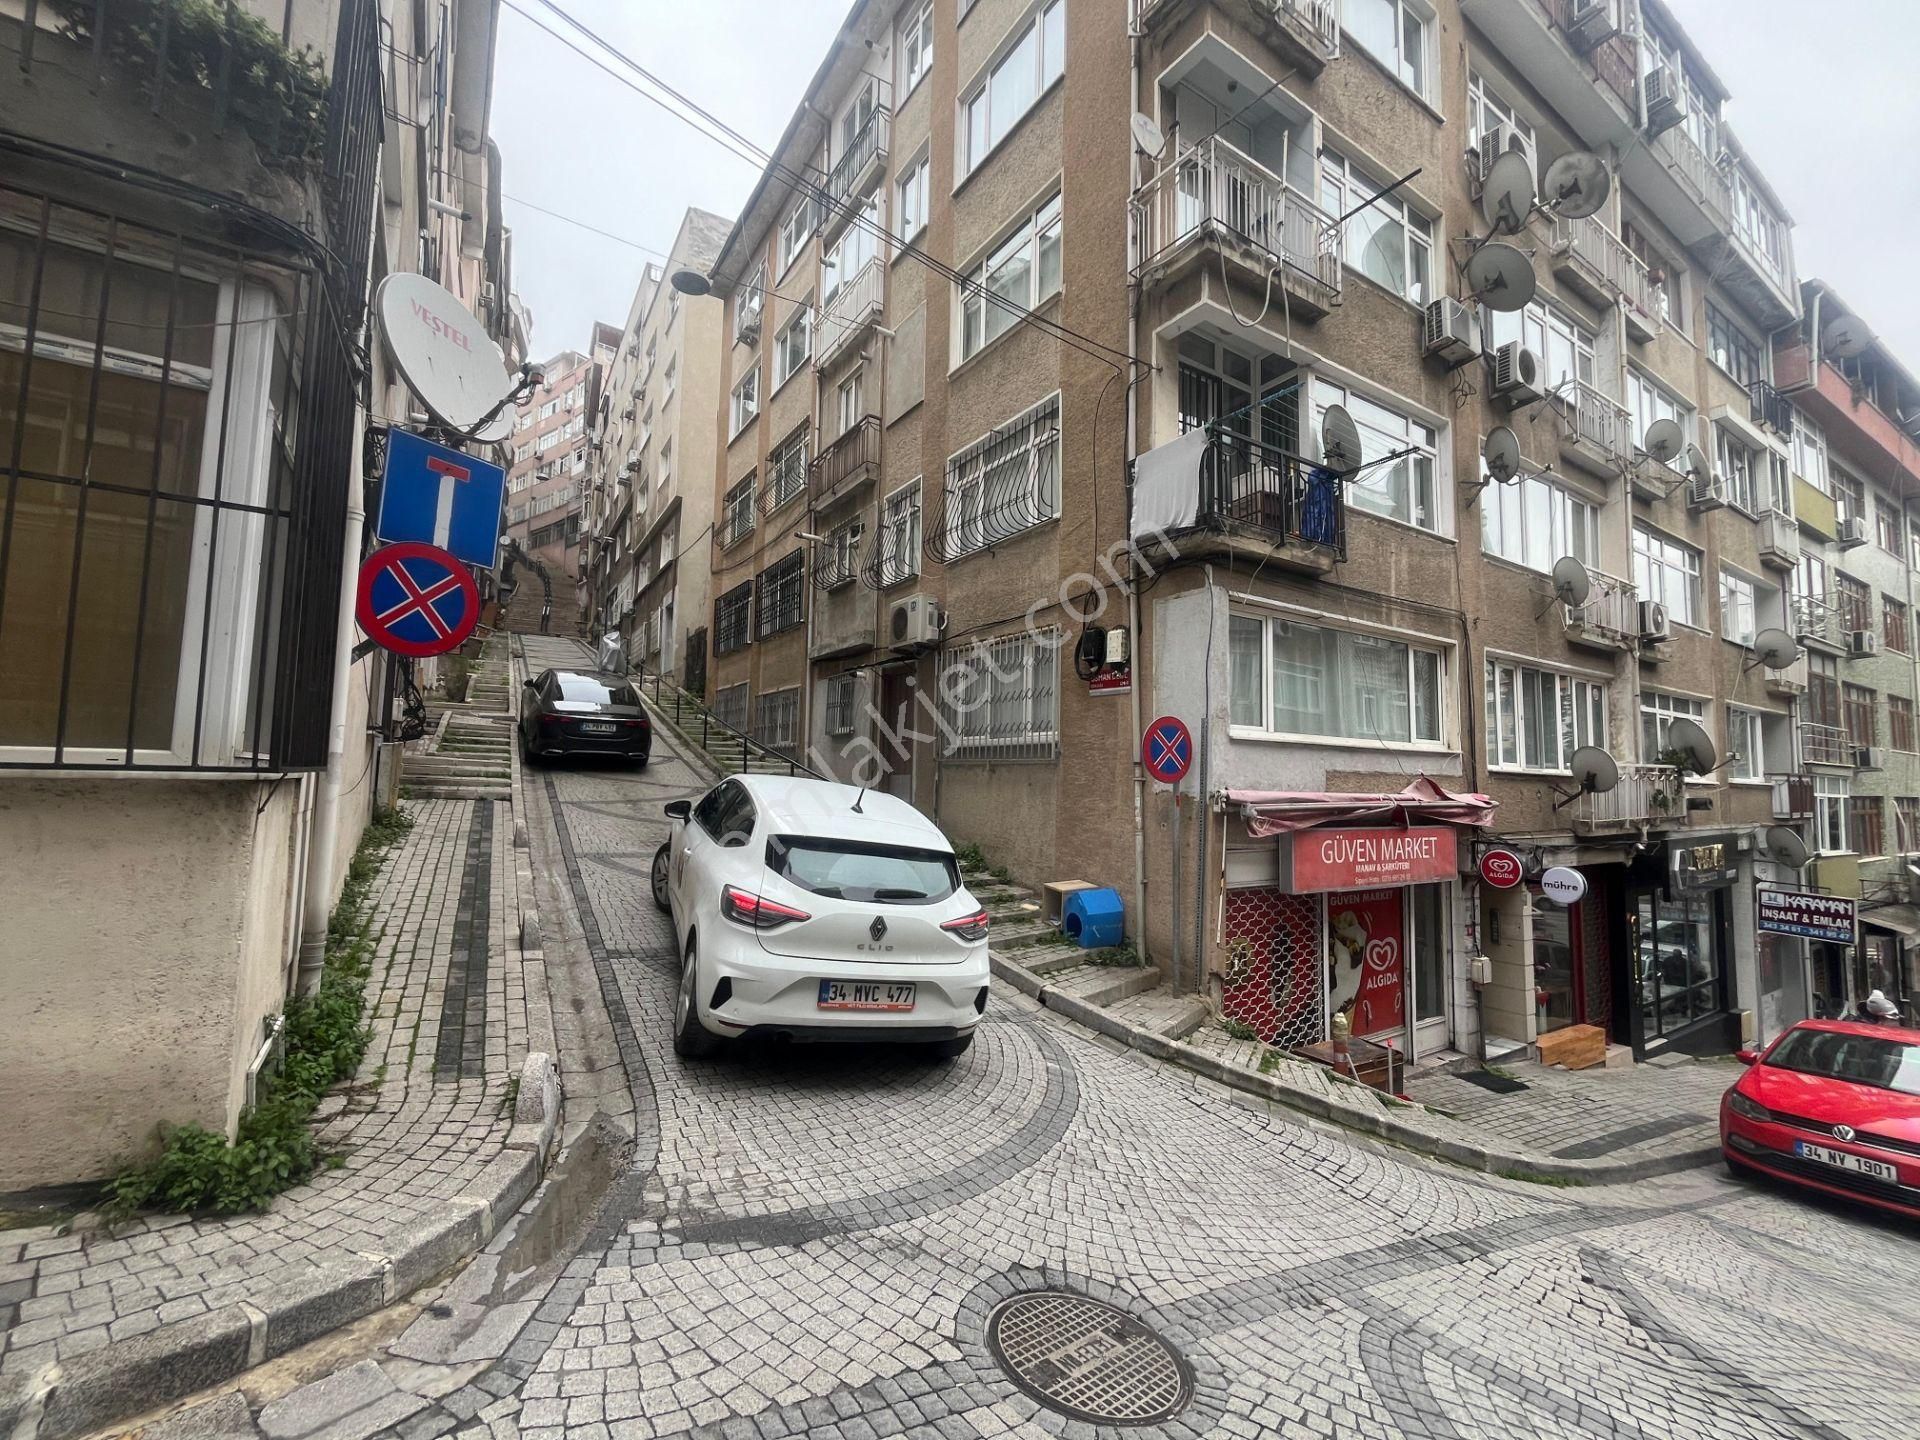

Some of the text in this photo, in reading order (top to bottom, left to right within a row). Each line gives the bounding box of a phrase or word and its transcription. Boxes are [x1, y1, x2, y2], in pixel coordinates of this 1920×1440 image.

[411, 297, 473, 352] VESTEL
[1321, 835, 1438, 864] GÜVEN MARKET
[1785, 895, 1853, 915] KARAMAN
[1761, 907, 1851, 929] İNŞAAT & EMLAK
[829, 984, 913, 1003] 34 MVC 477
[1804, 1145, 1891, 1179] 34 NV 1901
